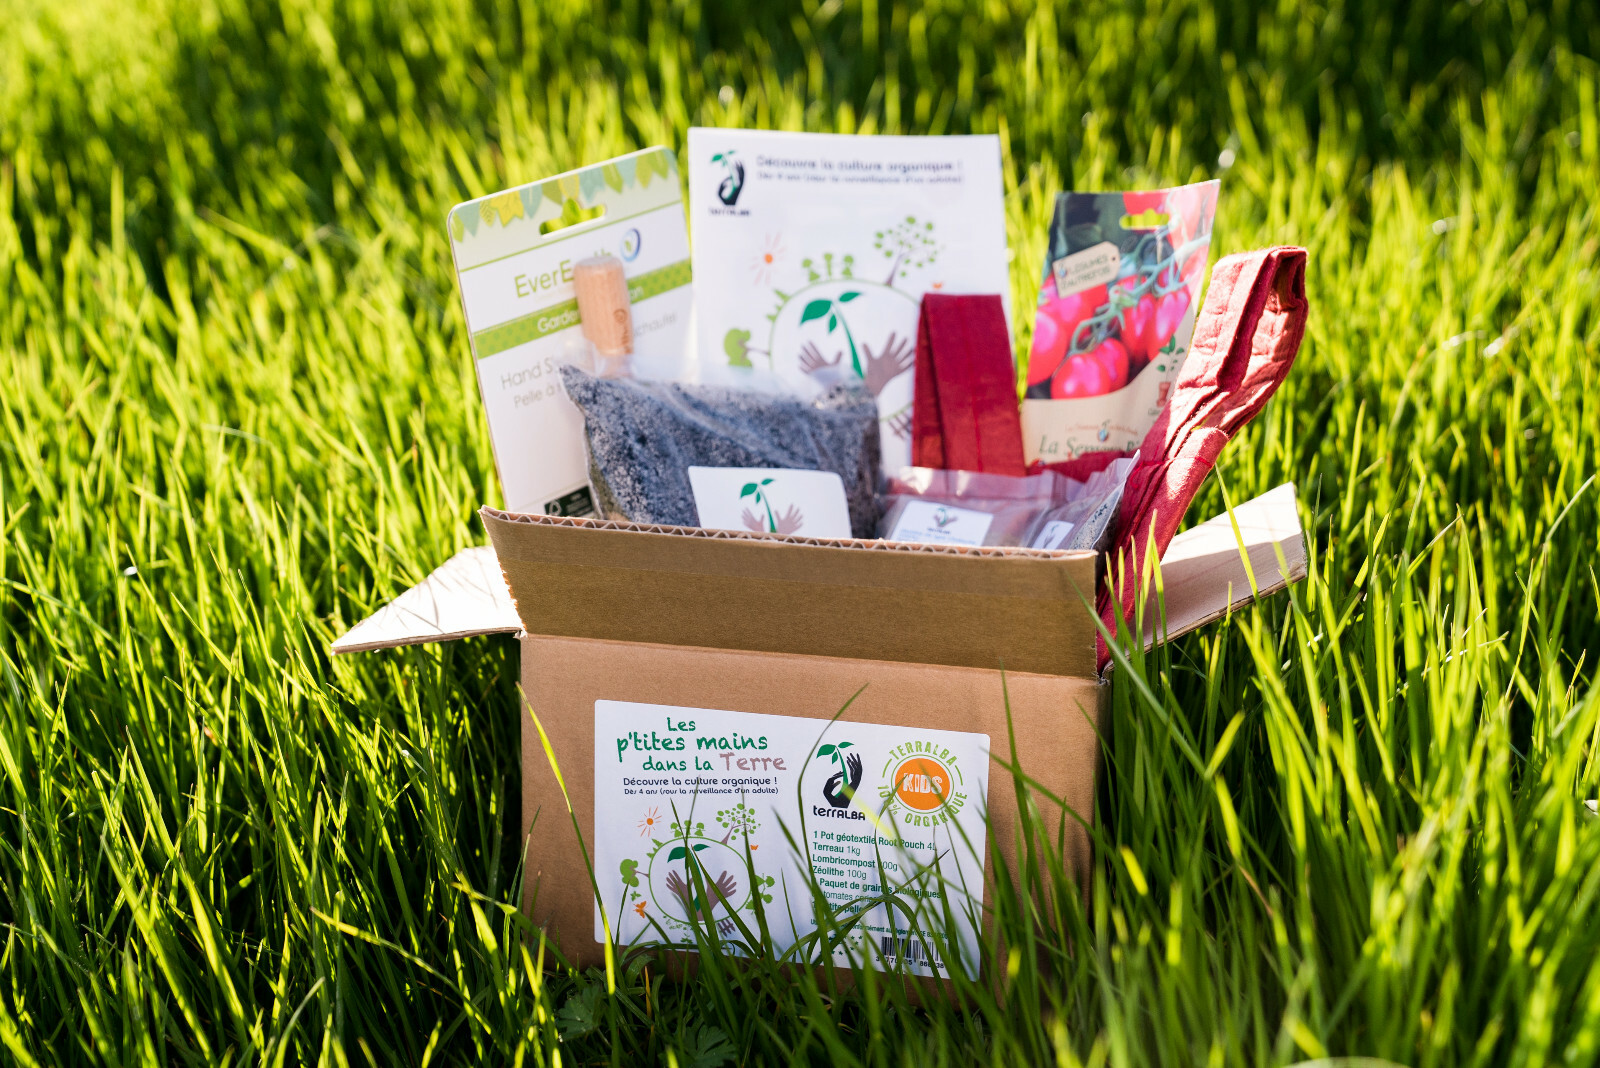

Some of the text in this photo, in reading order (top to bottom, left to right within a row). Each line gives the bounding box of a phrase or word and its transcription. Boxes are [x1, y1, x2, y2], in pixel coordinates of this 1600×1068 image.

[537, 309, 580, 332] Garde
[500, 361, 542, 390] Hand
[666, 716, 696, 732] Les
[616, 731, 768, 763] p'tites mains
[889, 740, 957, 767] TERRALBA
[642, 752, 787, 771] dans la Terre
[623, 777, 669, 786] Découvre
[671, 776, 682, 786] la
[684, 776, 718, 786] culture
[721, 776, 771, 787] organique
[902, 772, 943, 794] KIDS
[813, 830, 819, 839] 1
[820, 831, 835, 841] Pot
[836, 832, 876, 845] géotextile
[878, 836, 898, 847] Root
[812, 842, 861, 856] Terreau 1kg
[812, 854, 898, 872] Lombricompost 00g
[812, 865, 867, 880] Zéolithe 100g
[819, 877, 941, 898] Paquet de grains biologiues
[823, 890, 853, 901] tomates
